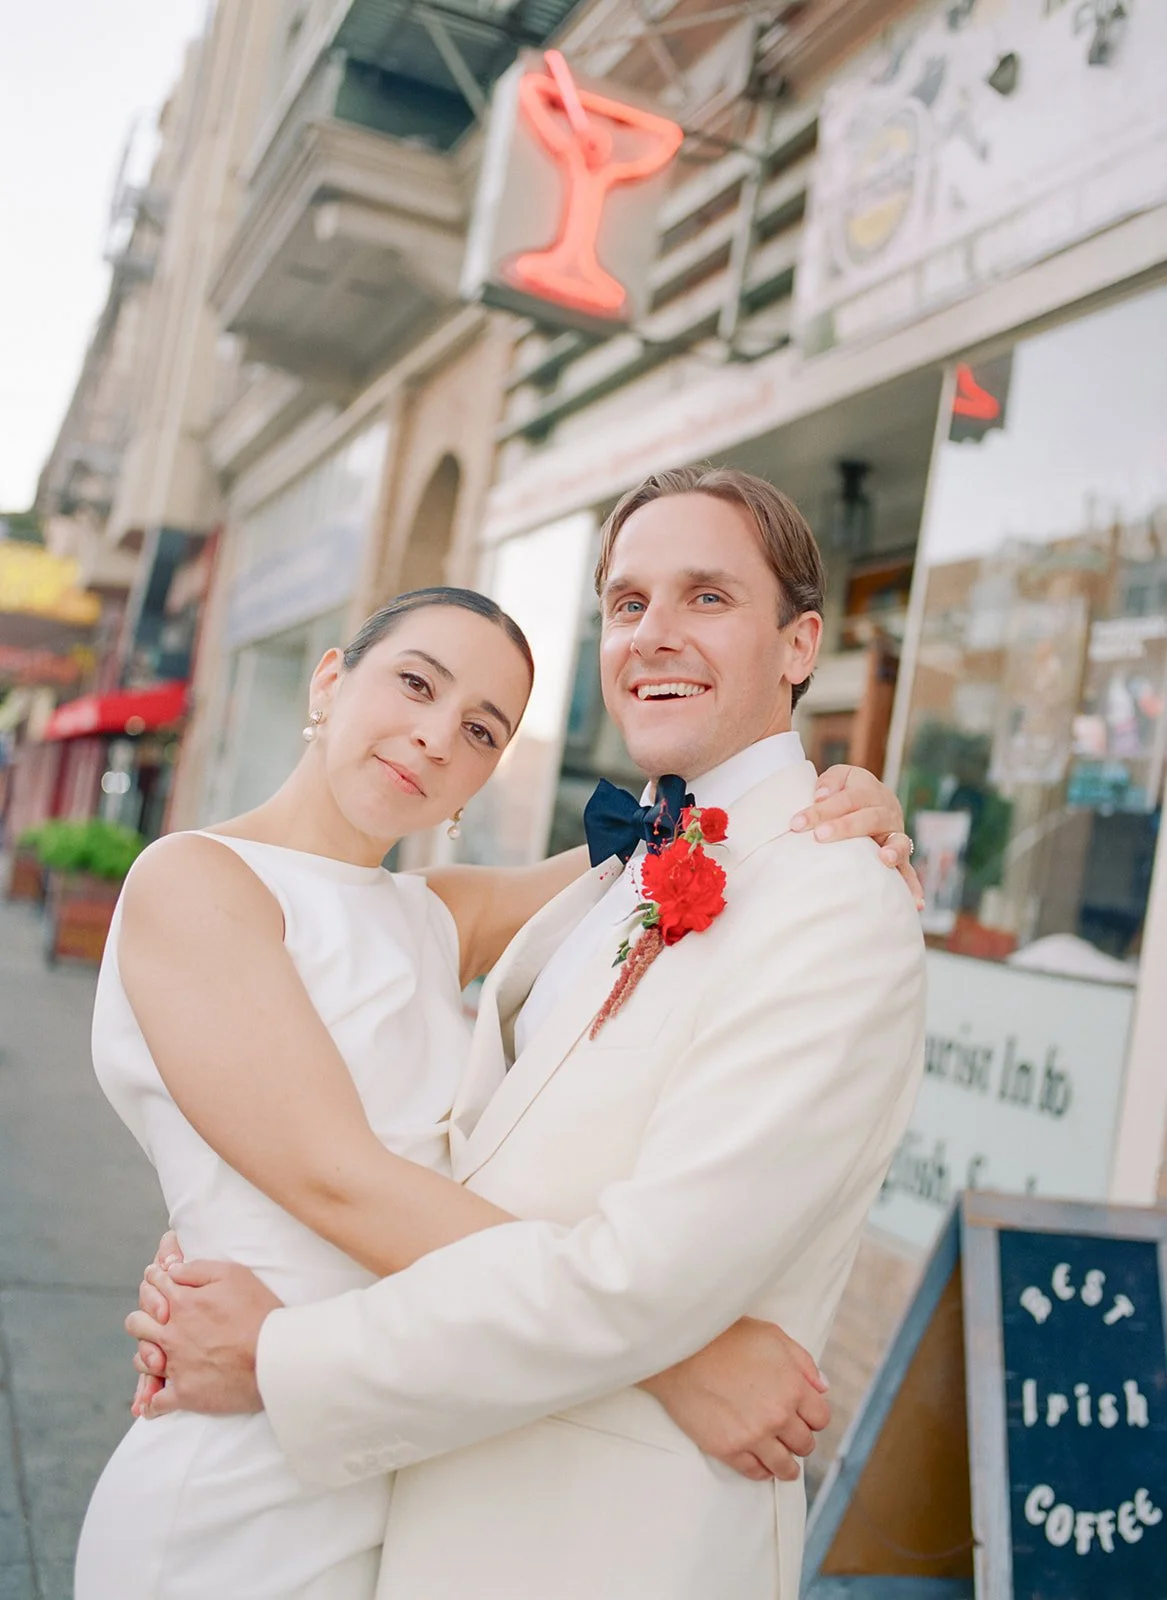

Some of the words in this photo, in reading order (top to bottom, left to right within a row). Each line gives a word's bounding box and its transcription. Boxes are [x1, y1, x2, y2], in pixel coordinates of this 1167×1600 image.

[924, 1023, 994, 1096] urist
[1020, 1262, 1136, 1326] BEST
[1021, 1377, 1150, 1429] Irish
[1024, 1483, 1164, 1556] COFFEE
